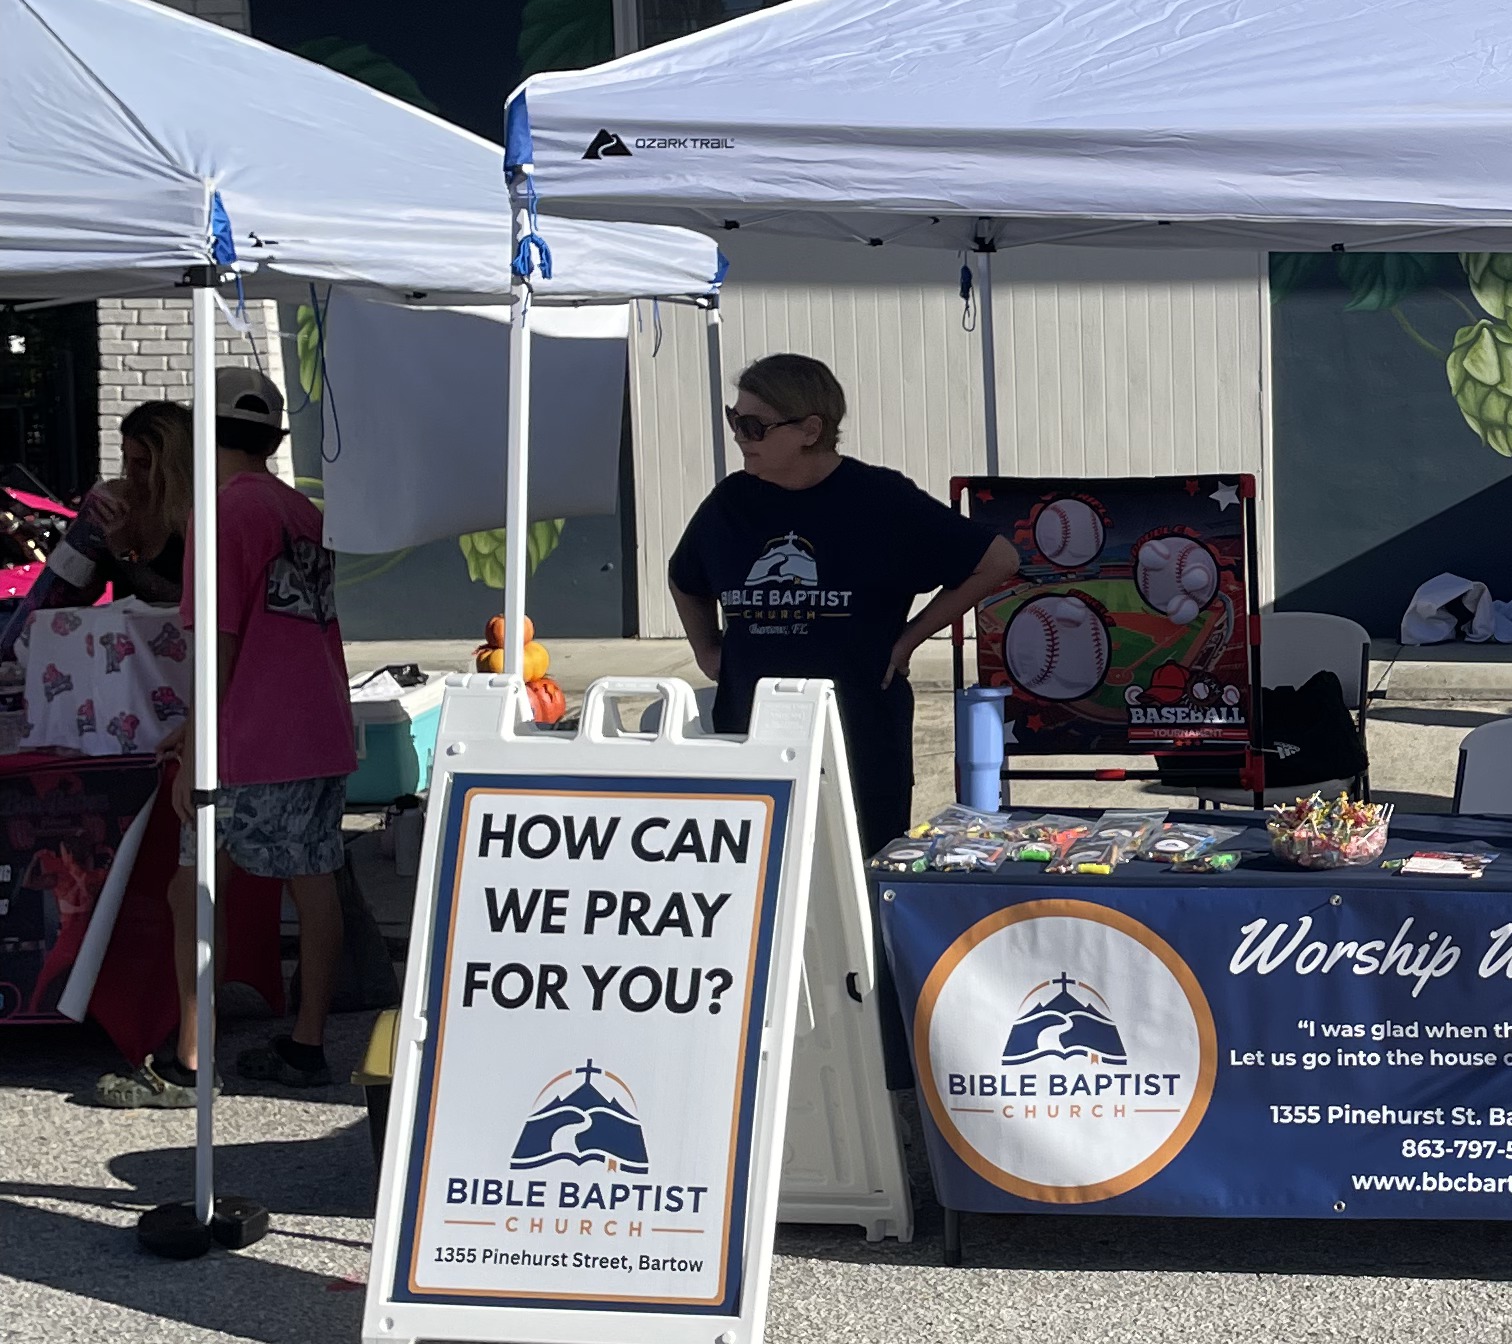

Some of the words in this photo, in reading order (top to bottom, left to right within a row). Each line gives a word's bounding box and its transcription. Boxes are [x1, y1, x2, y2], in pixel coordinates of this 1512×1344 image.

[721, 590, 763, 607] BIBLE
[768, 590, 852, 607] BAPTIST
[742, 609, 816, 620] CHURCH
[1130, 707, 1246, 724] BASEBALL
[1153, 728, 1223, 738] TOURNAMENT
[478, 813, 621, 860] HOW
[631, 817, 751, 863] CAN
[485, 888, 569, 934] WE
[584, 890, 731, 937] PRAY
[1230, 916, 1460, 997] Worship
[463, 962, 570, 1010] FOR
[582, 965, 733, 1014] YOU?
[1321, 1025, 1365, 1037] was
[1371, 1021, 1418, 1040] glad
[1424, 1019, 1487, 1040] when
[1231, 1050, 1265, 1065] Let
[1272, 1053, 1296, 1065] us
[1302, 1053, 1331, 1069] go
[1337, 1049, 1380, 1066] into
[1386, 1049, 1423, 1065] the
[1430, 1049, 1497, 1065] house
[949, 1074, 1036, 1096] BIBLE
[1049, 1074, 1180, 1096] BAPTIST
[1002, 1105, 1125, 1118] CHURCH
[1270, 1106, 1321, 1123] 1355
[1328, 1104, 1445, 1125] Pinehurst
[1452, 1107, 1481, 1125] St.
[447, 1178, 546, 1207] BIBLE
[559, 1182, 707, 1213] BAPTIST
[506, 1217, 642, 1237] CHURCH
[435, 1247, 476, 1263] 1355
[482, 1249, 568, 1267] Pinehurst
[573, 1252, 632, 1273] Street,
[639, 1255, 703, 1272] Bartow
